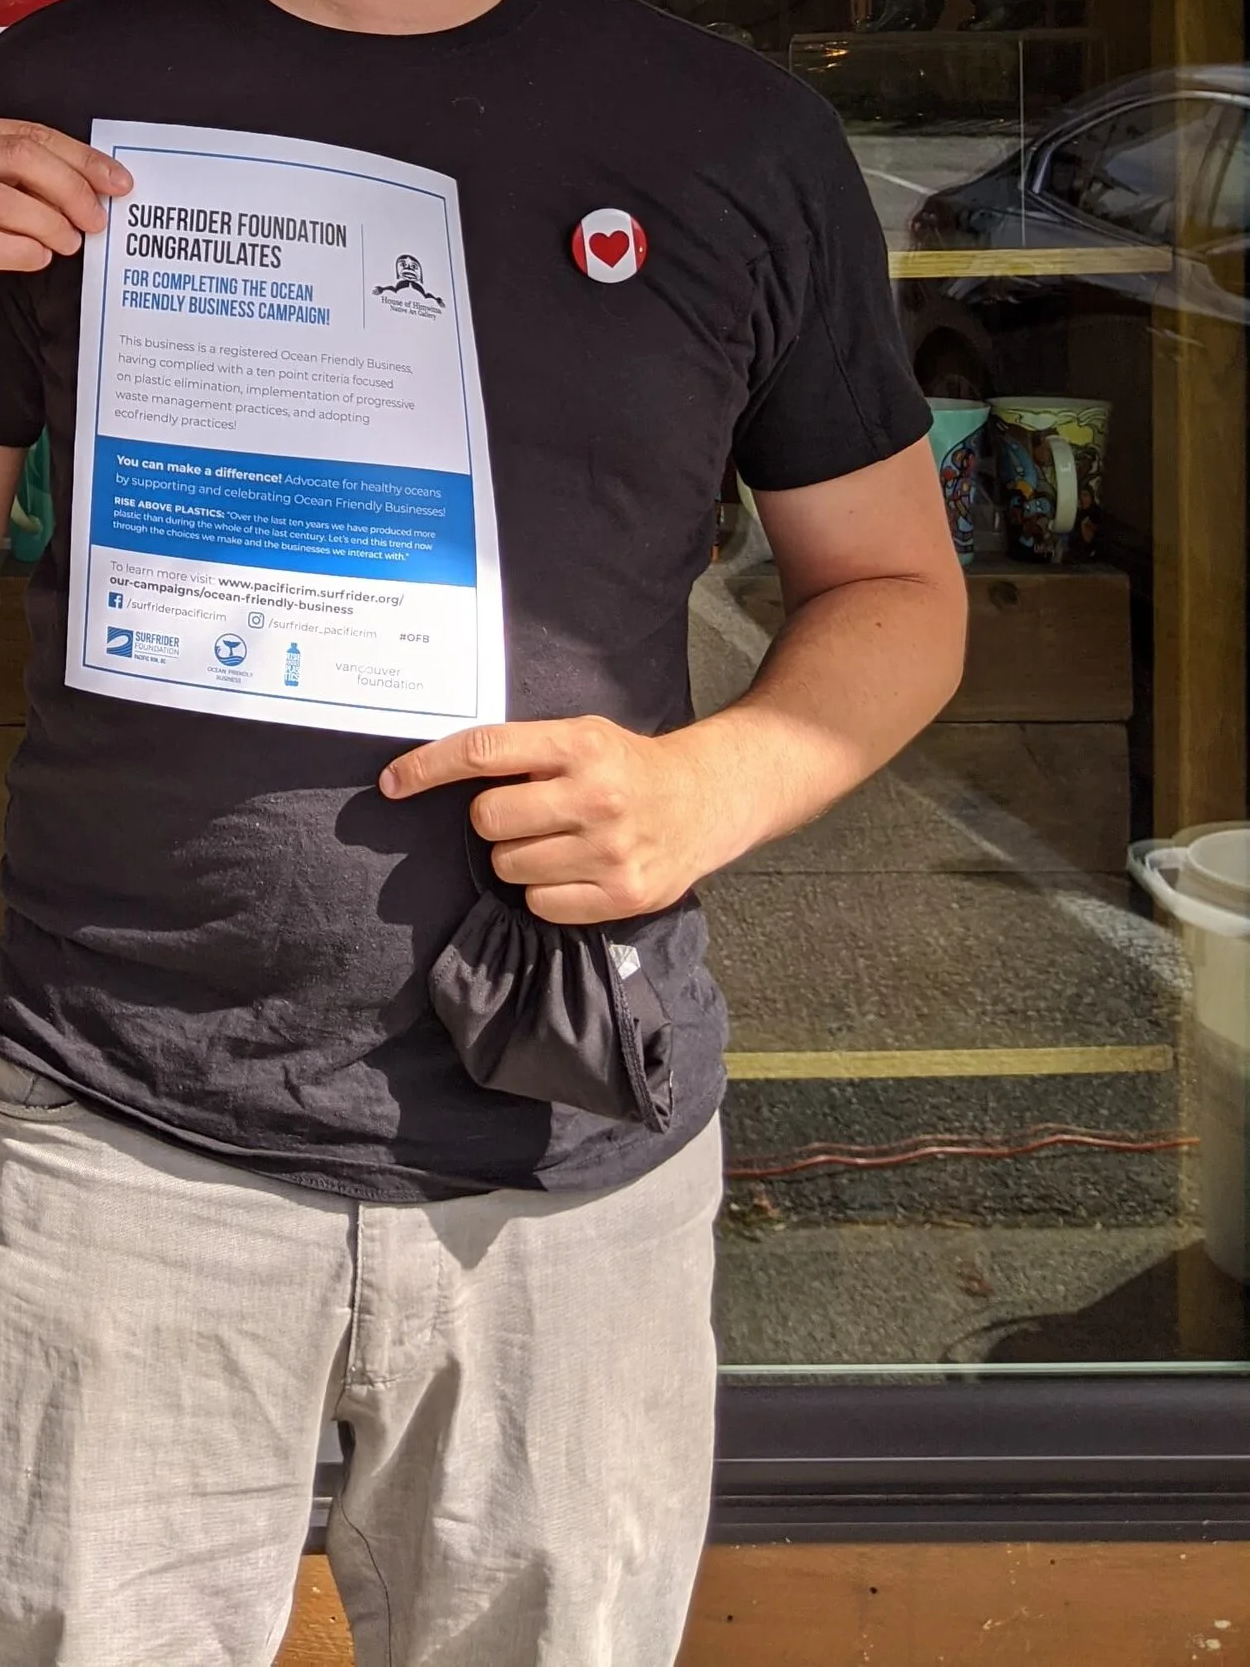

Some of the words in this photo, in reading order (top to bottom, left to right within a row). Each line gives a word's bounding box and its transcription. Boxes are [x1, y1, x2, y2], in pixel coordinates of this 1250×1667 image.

[128, 203, 232, 235] SURFRIDER
[238, 213, 347, 248] FOUNDATION
[126, 233, 282, 269] CONGRATULATES
[124, 269, 148, 287] FOR
[153, 272, 238, 295] COMPLETING
[242, 279, 266, 297] THE
[271, 282, 313, 301] OCEAN
[382, 296, 403, 306] House
[122, 290, 185, 312] FRIENDLY
[189, 296, 255, 318] BUSINESS
[259, 303, 330, 325] CAMPAIGN!
[118, 353, 156, 368] having
[159, 358, 214, 372] complied
[218, 364, 243, 374] with
[257, 367, 275, 377] ten
[279, 369, 308, 380] point
[312, 372, 350, 384] criteria
[353, 375, 393, 389] focused
[120, 335, 142, 347] This
[145, 338, 195, 352] business
[198, 343, 206, 353] is
[209, 346, 215, 354] a
[220, 345, 277, 359] registered
[281, 350, 317, 362] Ocean
[321, 354, 364, 369] Friendly
[367, 359, 413, 374] Business,
[116, 391, 148, 402] waste
[152, 394, 232, 411] management
[236, 402, 290, 417] practices,
[293, 408, 315, 418] and
[318, 410, 370, 425] adopting
[117, 373, 131, 382] on
[135, 374, 171, 387] plastic
[174, 378, 243, 394] elimination,
[246, 384, 339, 401] implementation
[343, 393, 353, 403] of
[357, 395, 415, 410] progressive
[115, 408, 178, 426] ecofriendly
[181, 417, 236, 430] practices!
[117, 455, 139, 467] You
[142, 460, 163, 470] can
[167, 463, 201, 475] make
[205, 467, 211, 476] a
[215, 467, 281, 483] difference!
[284, 474, 340, 489] Advocate
[343, 479, 357, 490] for
[361, 481, 402, 496] healthy
[405, 486, 441, 498] oceans
[116, 473, 129, 485] by
[132, 477, 195, 494] supporting
[199, 485, 221, 495] and
[225, 487, 291, 505] celebrating
[294, 494, 332, 507] Ocean
[336, 497, 382, 513] Friendly
[385, 502, 446, 517] Businesses!
[114, 510, 141, 520] plastic
[143, 511, 163, 523] than
[165, 515, 195, 528] during
[197, 518, 212, 529] the
[215, 521, 242, 533] whole
[244, 526, 253, 534] of
[255, 526, 270, 536] the
[272, 528, 288, 538] last
[289, 531, 326, 542] century.
[351, 536, 368, 546] end
[371, 537, 387, 547] this
[389, 539, 412, 550] trend
[414, 543, 432, 551] now
[115, 496, 135, 507] RISE
[138, 499, 172, 512] ABOVE
[175, 505, 225, 518] PLASTICS:
[254, 513, 268, 523] the
[271, 516, 286, 525] last
[289, 518, 303, 527] ten
[305, 520, 329, 530] years
[332, 523, 345, 531] we
[347, 523, 368, 533] have
[370, 526, 412, 537] produced
[414, 530, 435, 539] more
[113, 521, 147, 534] through
[150, 525, 165, 535] the
[167, 529, 199, 540] choices
[218, 534, 242, 545] make
[244, 537, 262, 547] and
[264, 538, 280, 549] the
[282, 541, 330, 554] businesses
[348, 549, 382, 560] interact
[110, 577, 354, 615] our-campaigns/ocean-friendly-business
[111, 561, 123, 572] To
[126, 563, 153, 577] learn
[157, 569, 187, 582] more
[218, 577, 404, 606] www.pacificrim.surfrider.org/
[127, 598, 227, 622] /surfriderpacificrim
[268, 618, 377, 639] /surfrider_pacificrim
[399, 633, 430, 643] #OFB
[134, 643, 179, 656] FOUNDATION
[135, 631, 180, 648] SURFRIDER
[207, 666, 226, 675] OCEAN
[336, 662, 401, 677] vancouver
[357, 674, 424, 691] foundation
